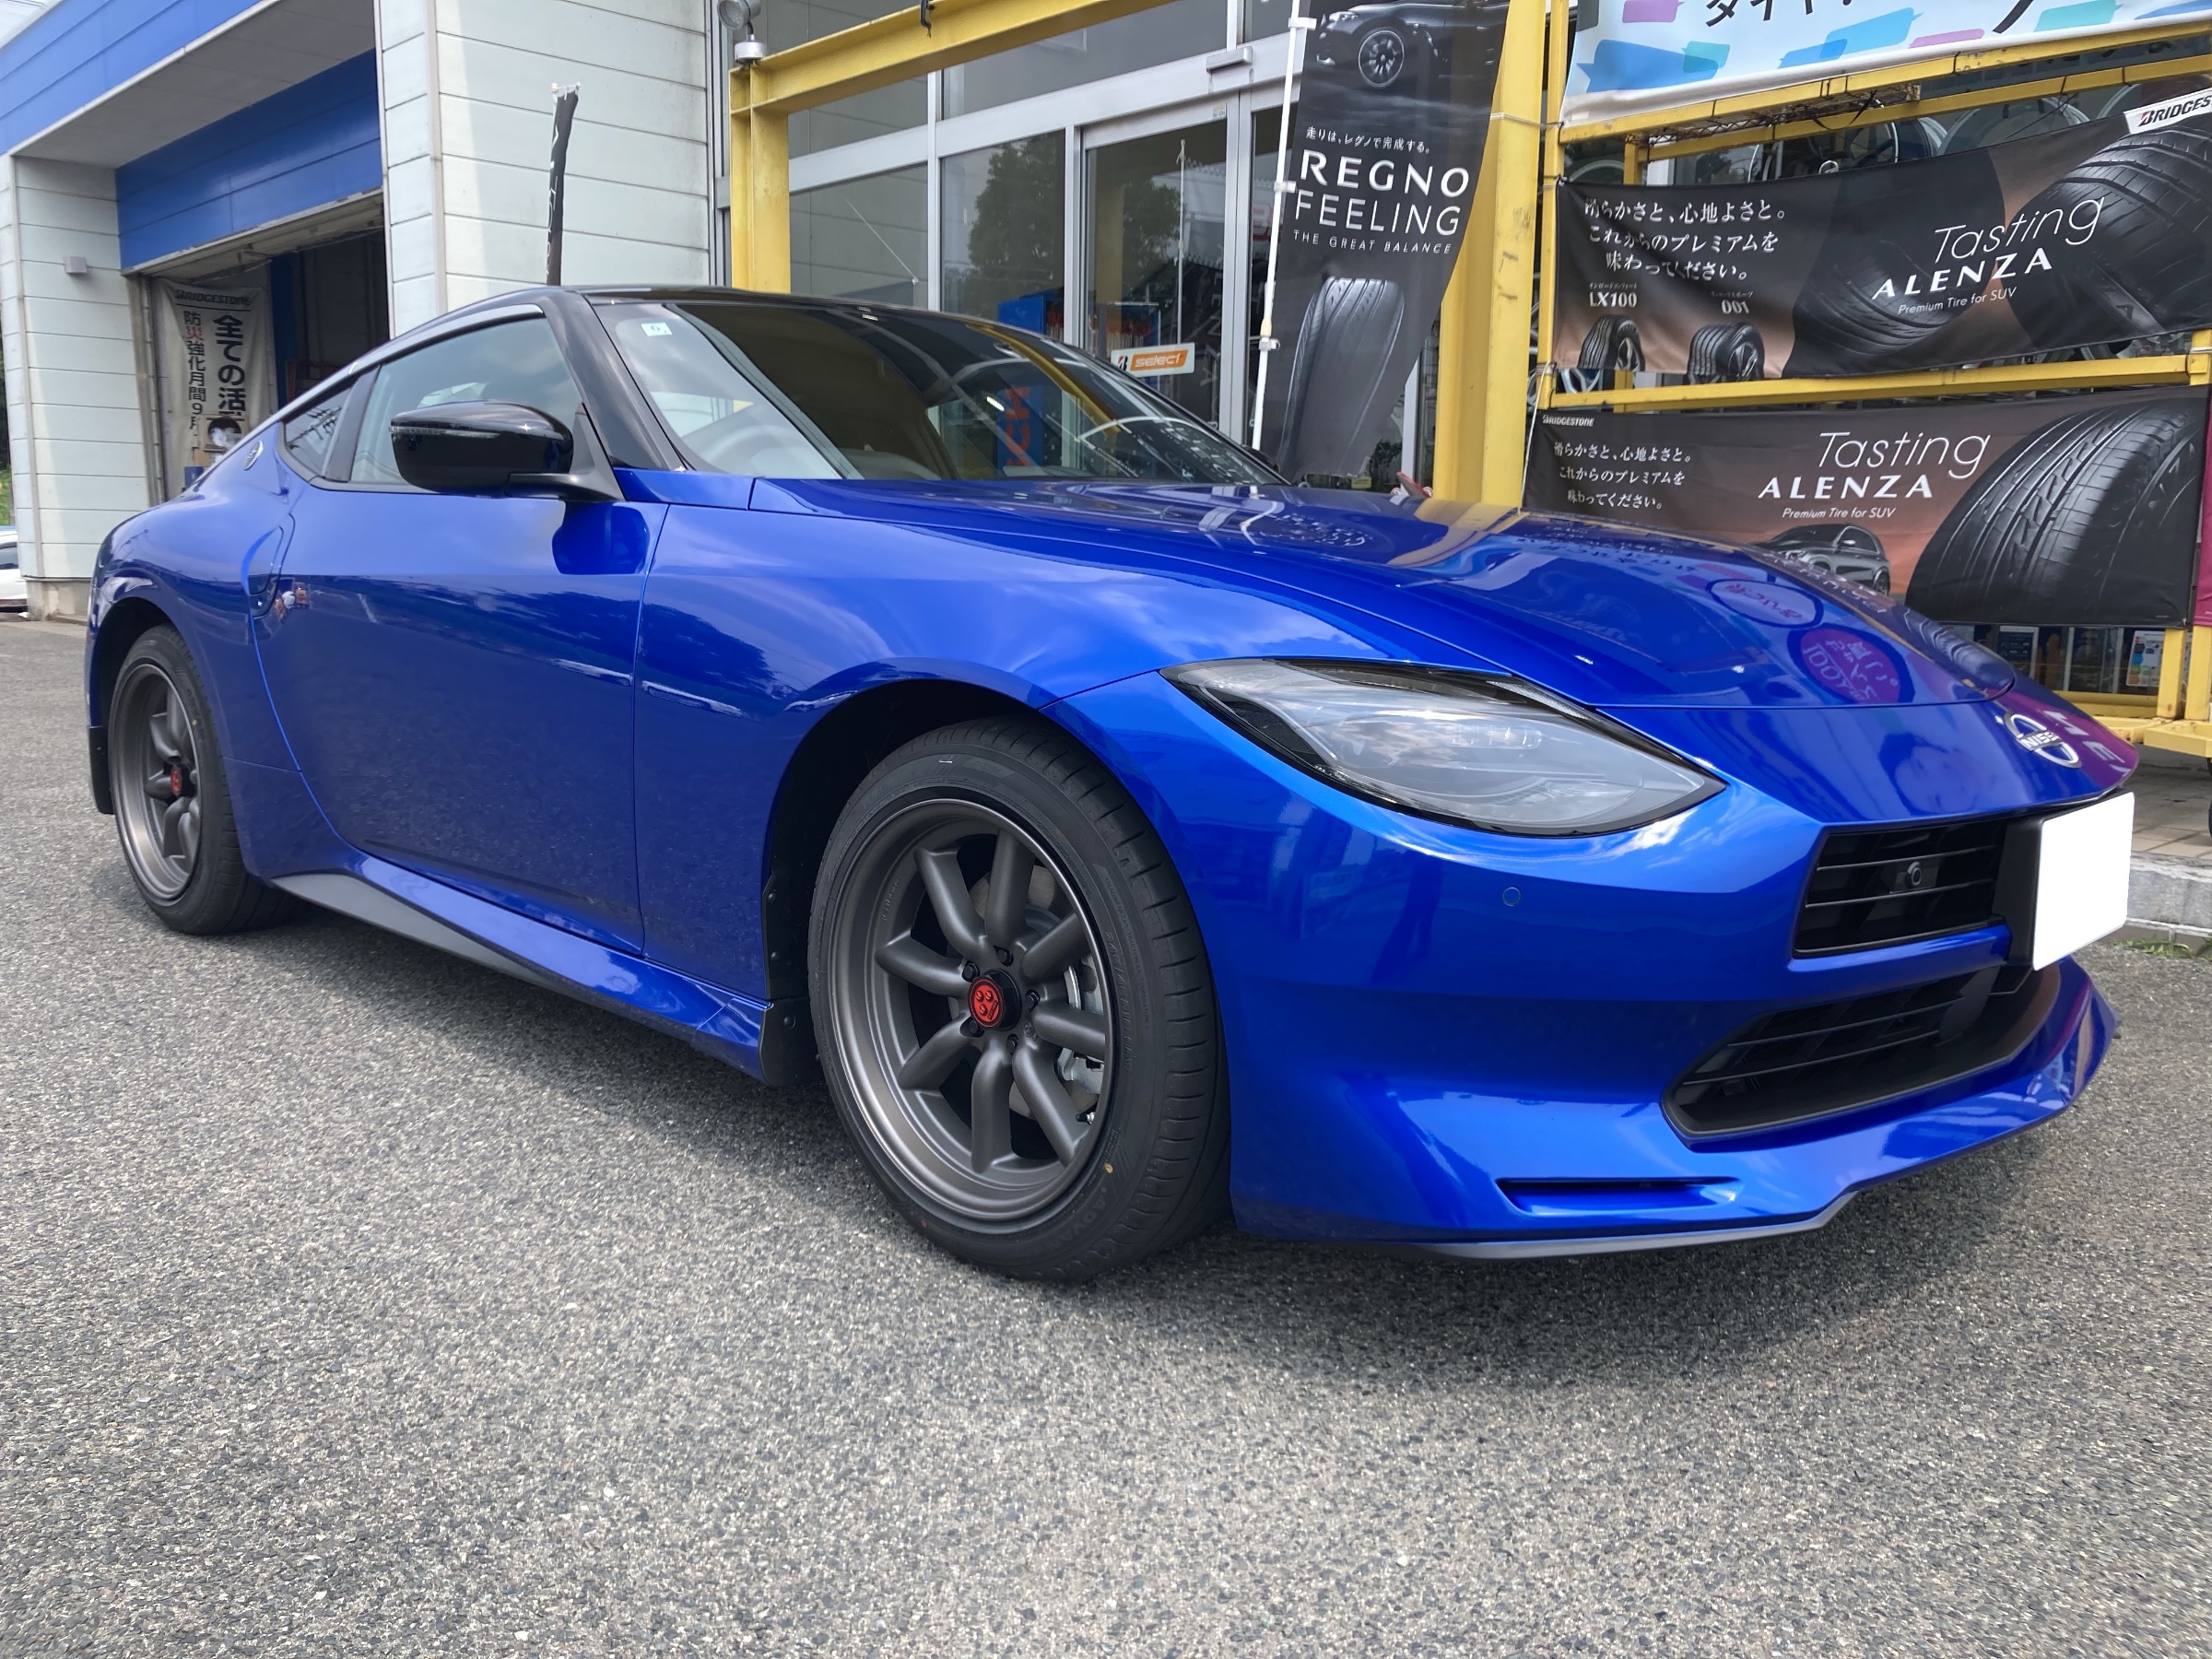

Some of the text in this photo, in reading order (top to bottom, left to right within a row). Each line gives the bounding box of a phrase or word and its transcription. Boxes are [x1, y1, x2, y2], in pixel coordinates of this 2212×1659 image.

[1306, 125, 1430, 155] 走りは、レグノで完成する。
[1300, 149, 1469, 197] REGNO
[1295, 189, 1461, 236] FEELING
[1293, 229, 1452, 254] THE GREAT BALANCE
[1589, 225, 1779, 253] これからのプレミアムを
[1935, 196, 2105, 264] Tasting
[1606, 251, 1747, 280] 味わってください。
[1872, 247, 2052, 300] ALENZA
[1589, 291, 1638, 308] LX100
[1721, 300, 1750, 314] 001
[1898, 286, 2018, 315] Premium Tire for SUV
[213, 314, 247, 416] 全ての活
[1542, 415, 1594, 427] BRIDGESTONE
[1818, 431, 1991, 480] Tasting
[1559, 466, 1685, 486] これからのプレミアムを
[1758, 475, 1933, 499] ALENZA
[1568, 489, 1662, 509] 味わってください。
[1782, 507, 1896, 519] Premium Tire for SUV
